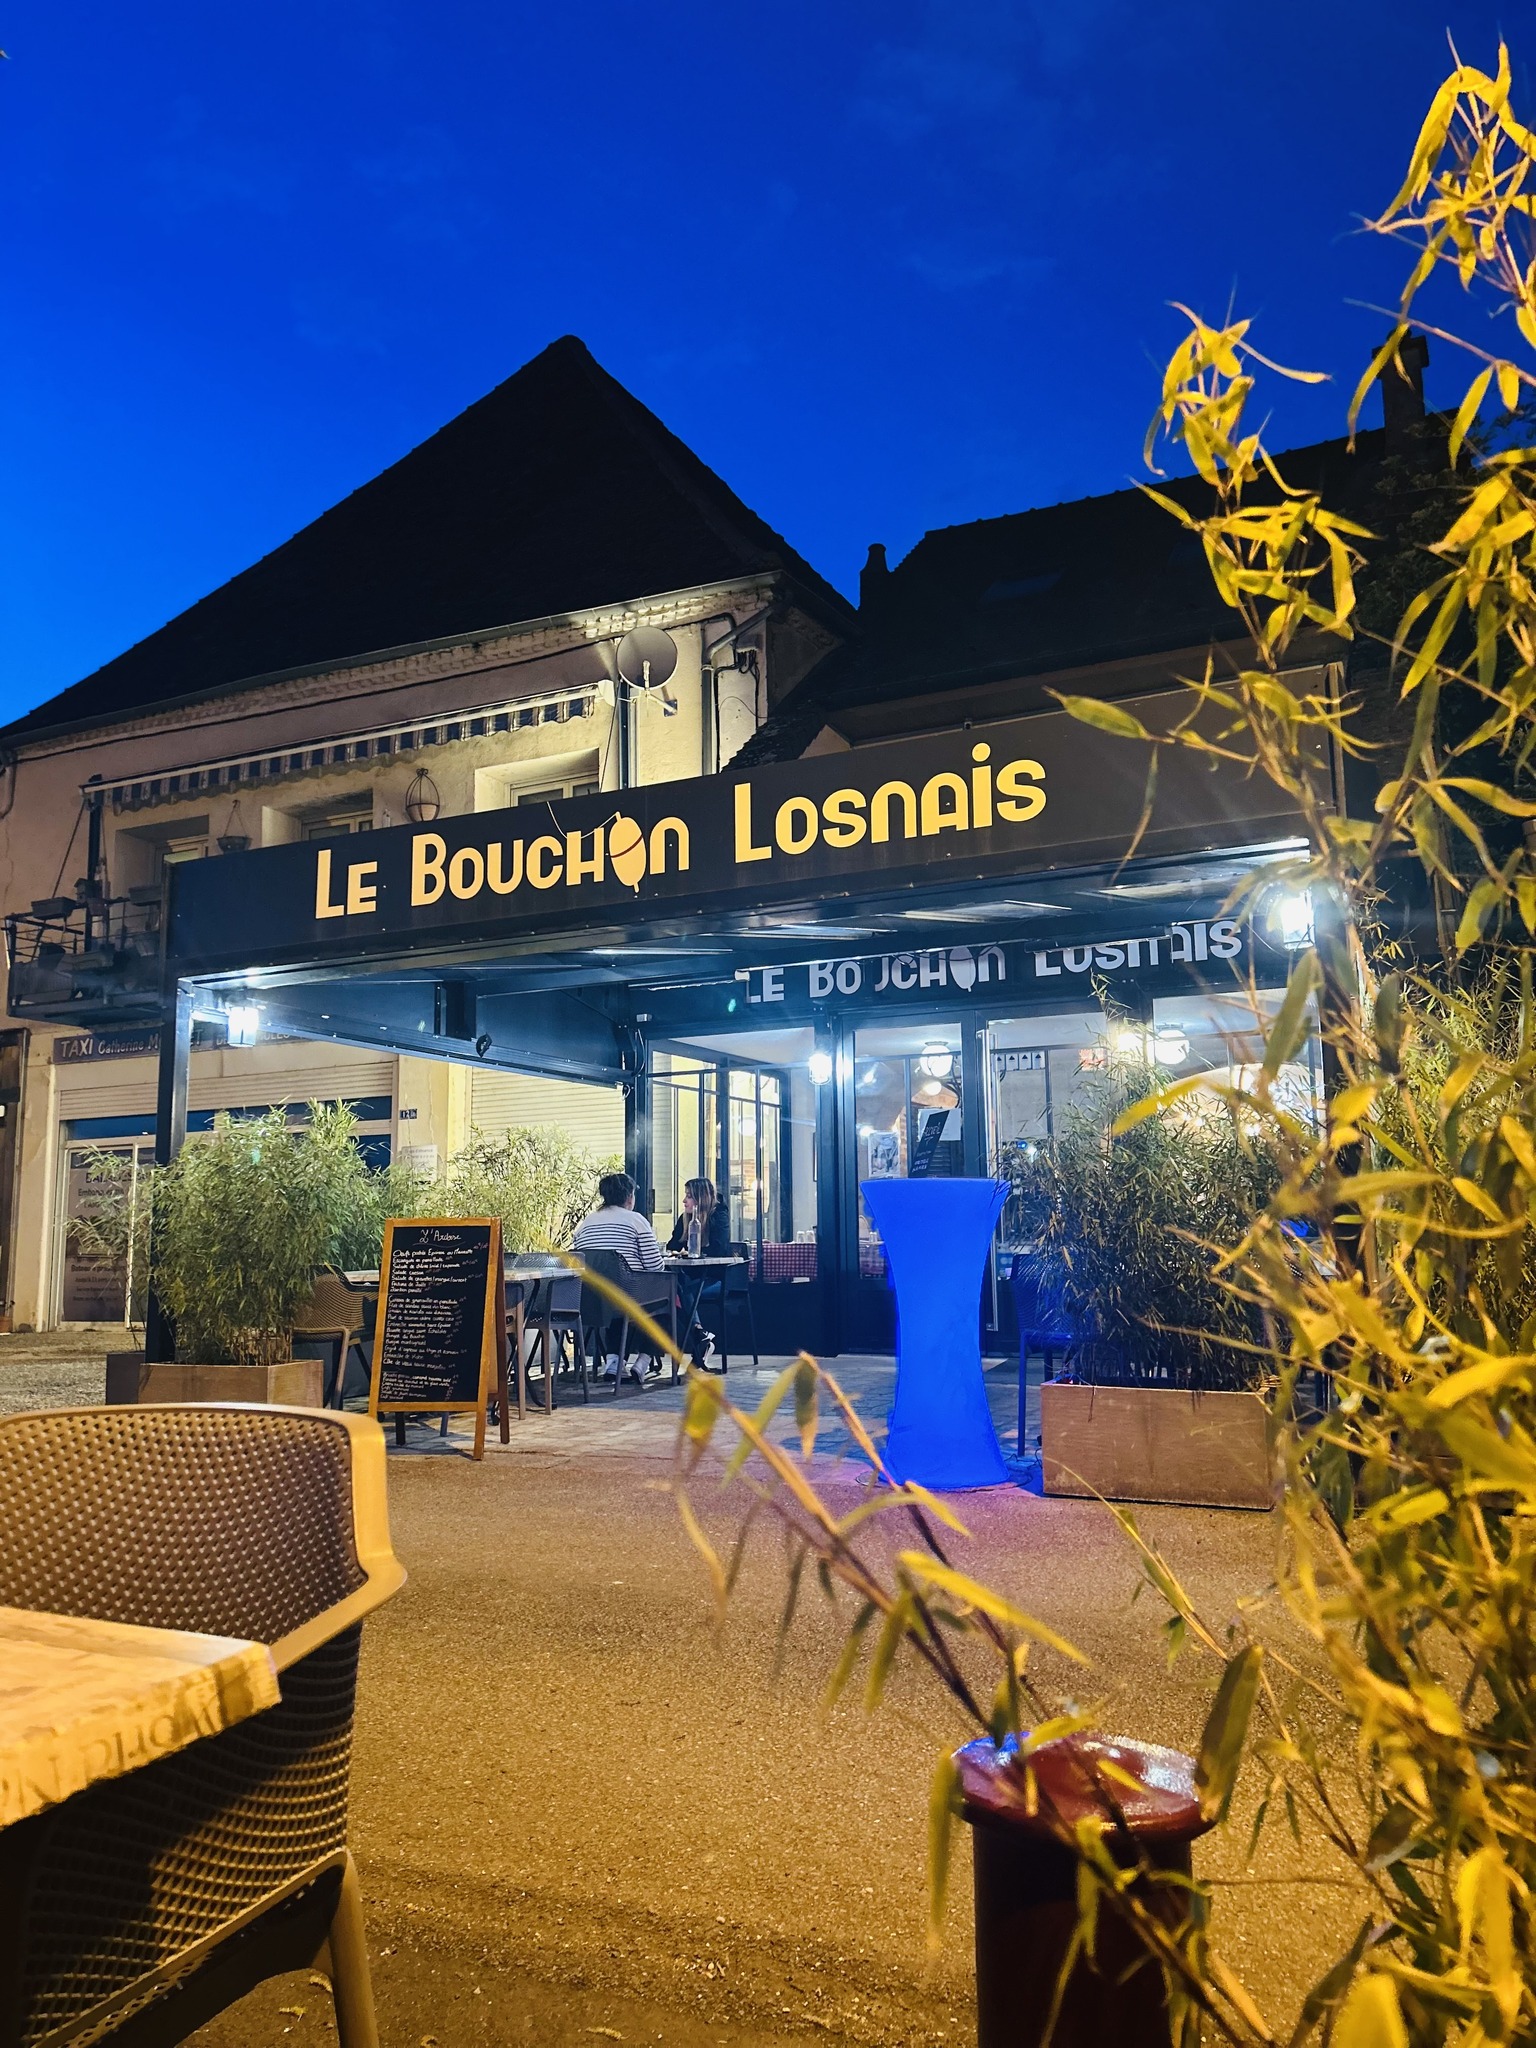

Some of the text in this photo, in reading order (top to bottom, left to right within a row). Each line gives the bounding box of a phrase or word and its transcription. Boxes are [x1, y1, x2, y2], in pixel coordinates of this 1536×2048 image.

[315, 848, 378, 919] LE
[410, 810, 690, 907] BOUCHON
[60, 1037, 94, 1058] TAXI
[98, 1037, 145, 1055] Catherine
